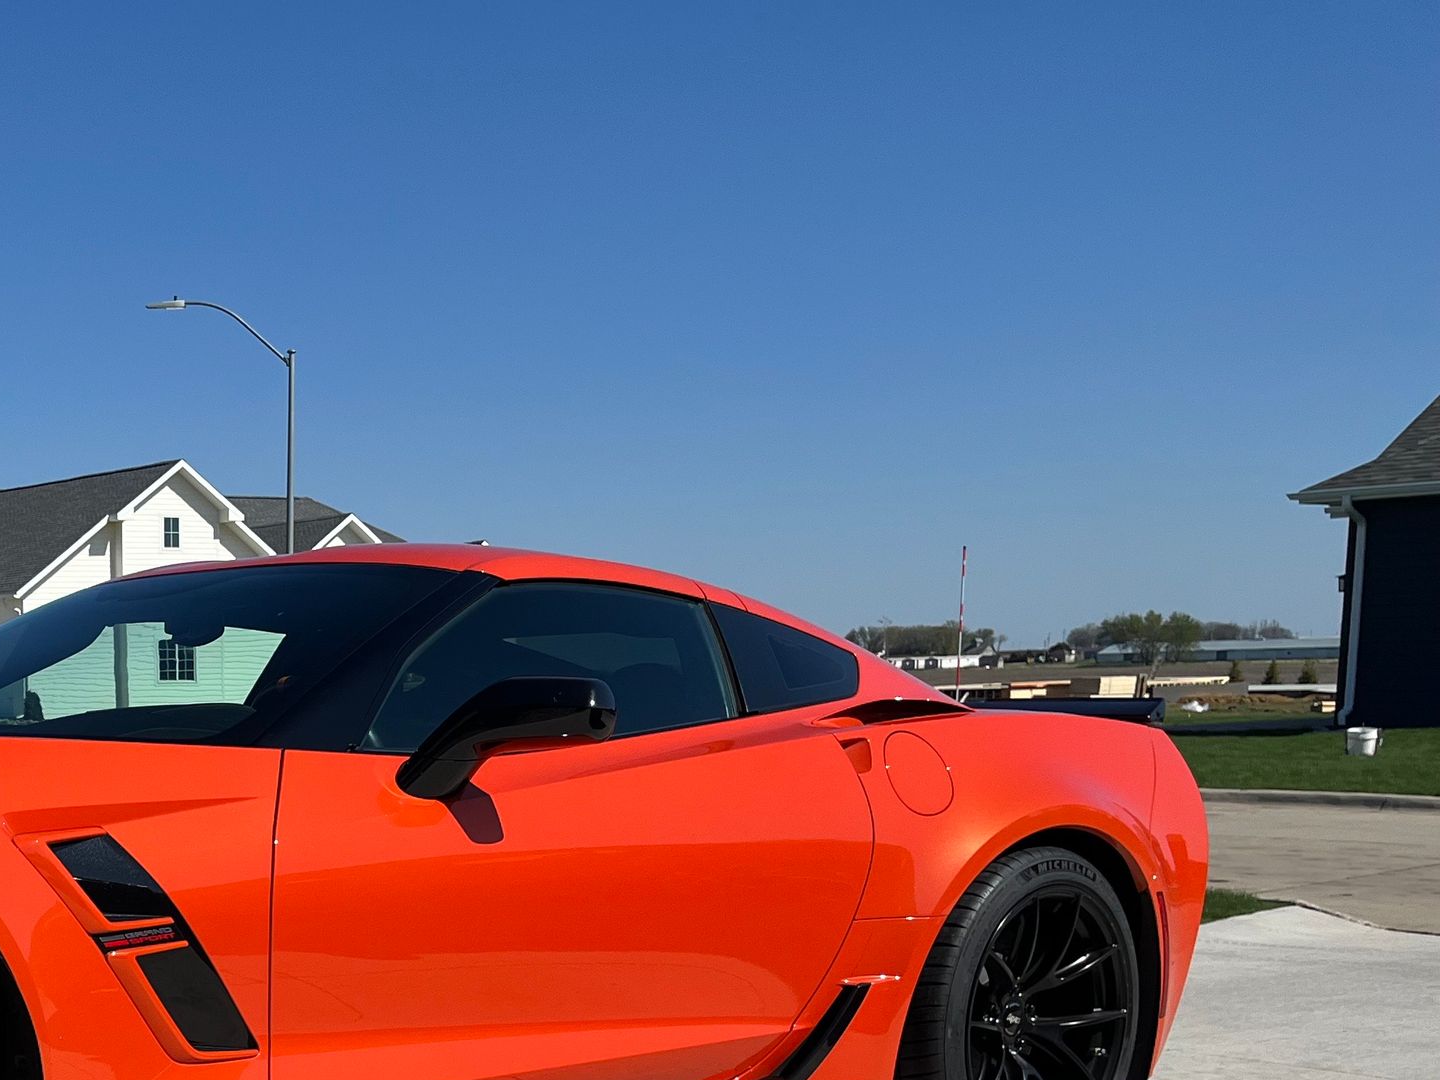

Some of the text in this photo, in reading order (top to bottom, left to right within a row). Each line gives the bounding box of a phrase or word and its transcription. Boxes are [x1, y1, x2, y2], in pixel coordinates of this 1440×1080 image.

[1037, 860, 1094, 880] MICHELIN
[125, 927, 172, 939] GRAND
[129, 933, 175, 944] SPORT
